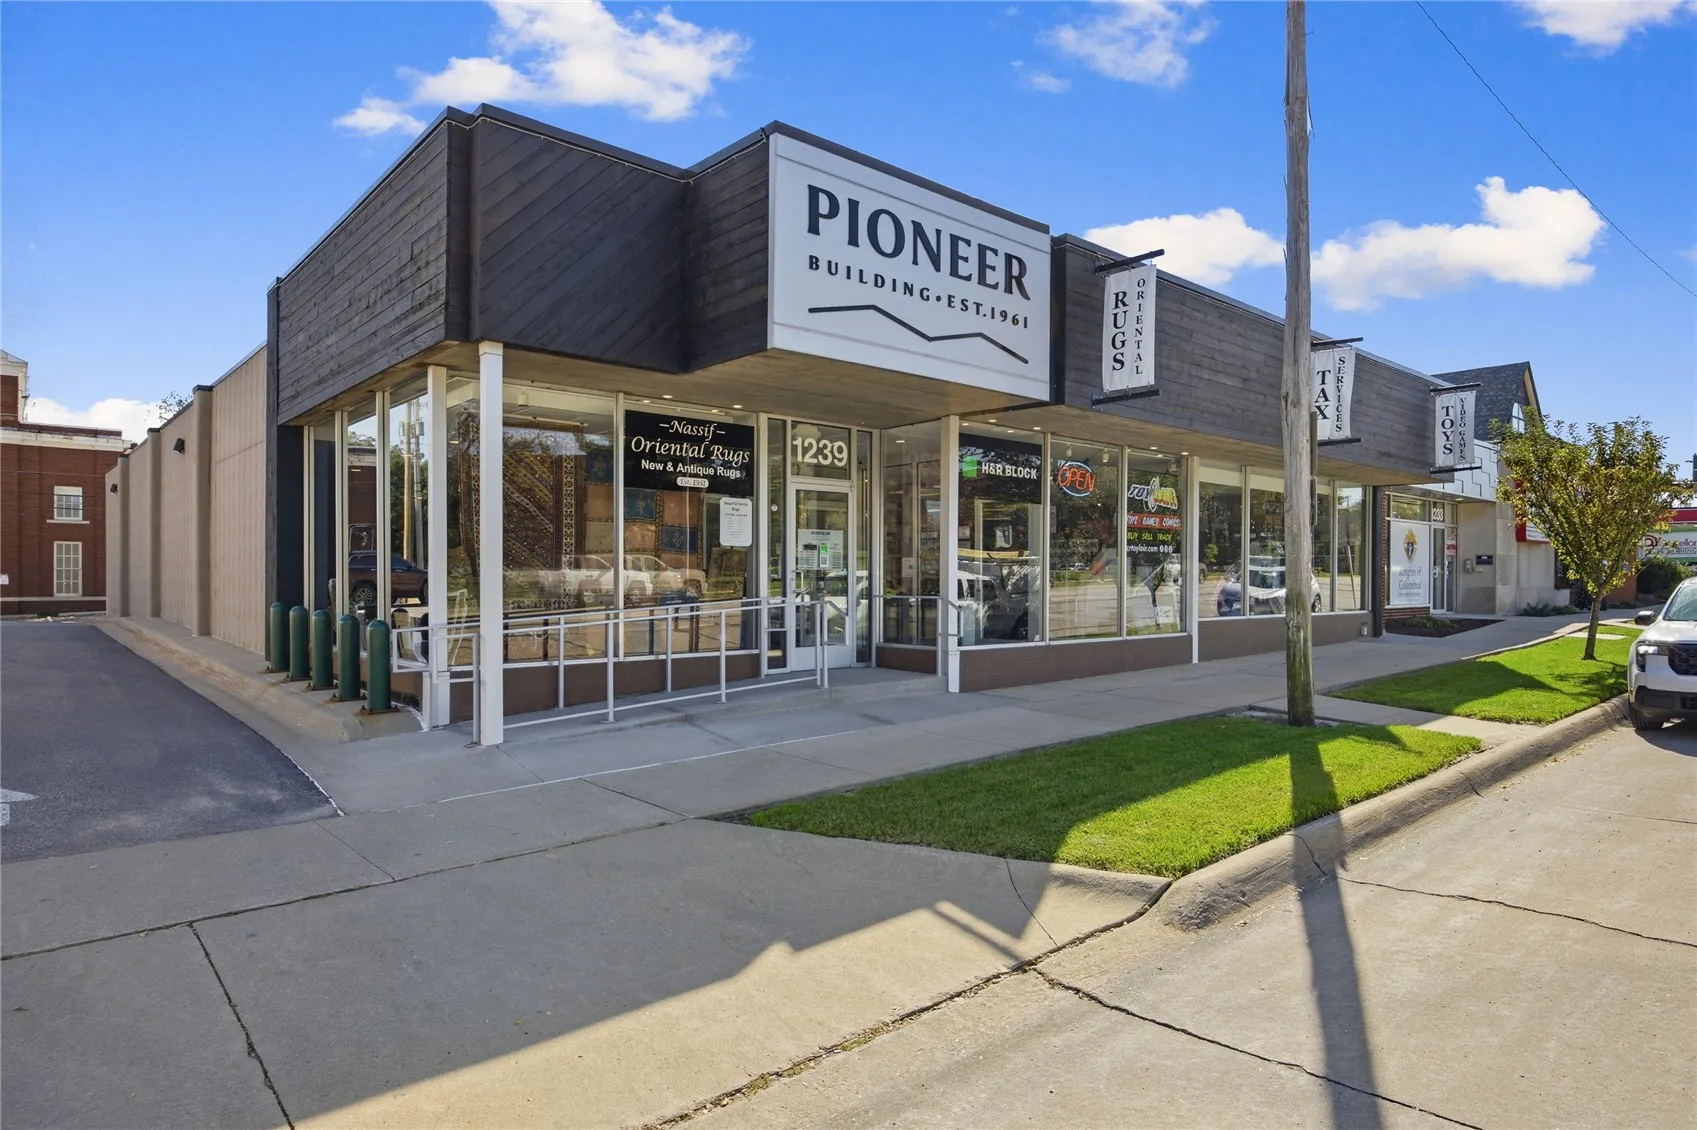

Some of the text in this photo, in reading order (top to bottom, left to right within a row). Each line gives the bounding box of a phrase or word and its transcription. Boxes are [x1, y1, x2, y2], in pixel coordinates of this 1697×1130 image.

[807, 184, 1031, 301] PIONEER
[1111, 290, 1130, 371] RUGS
[1134, 278, 1146, 375] ORIENTAL
[1314, 369, 1332, 420] TAX
[1335, 356, 1346, 432] SERVICES
[1441, 405, 1455, 455] TOYS
[631, 435, 751, 467] Oriental Rugs
[641, 459, 741, 479] New & Antique Rugs
[792, 437, 848, 467] 1239
[982, 462, 1038, 480] H&R BLOCK
[1057, 464, 1097, 493] OPEN
[1127, 531, 1173, 542] BUY SELL TRADE
